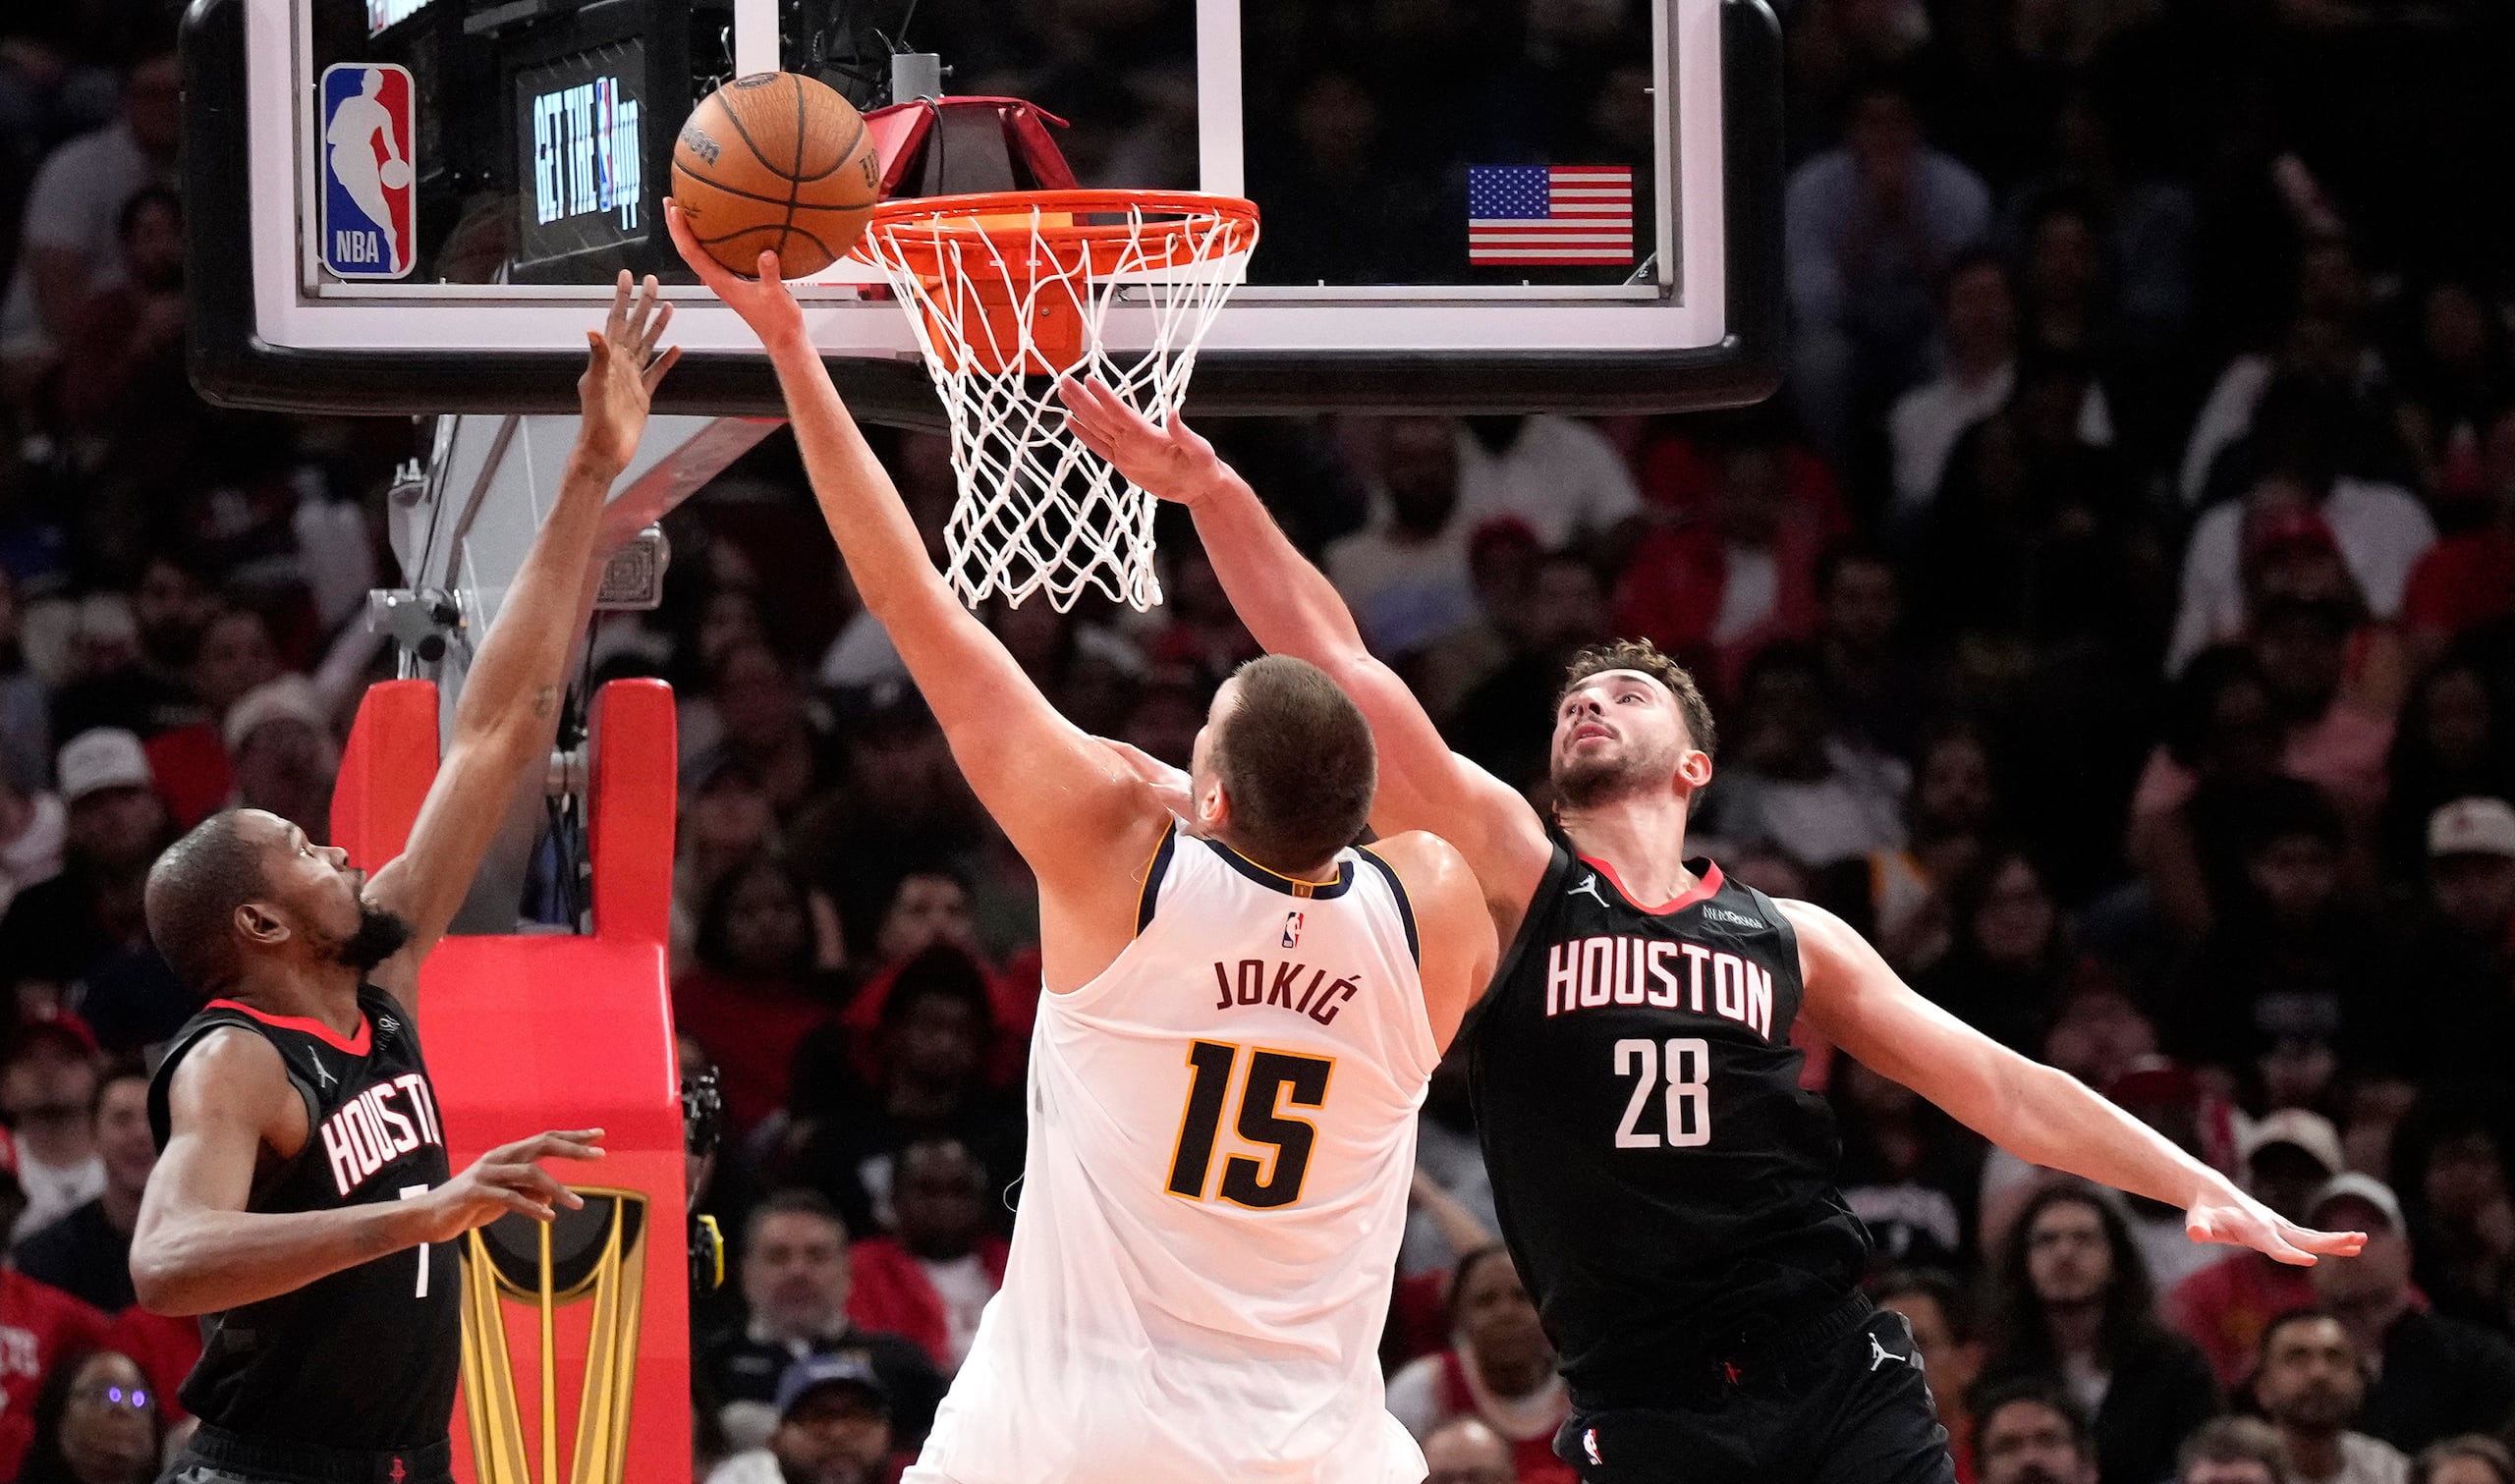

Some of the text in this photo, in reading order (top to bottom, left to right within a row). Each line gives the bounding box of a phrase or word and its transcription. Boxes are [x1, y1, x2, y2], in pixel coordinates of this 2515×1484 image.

[564, 83, 597, 216] THE
[336, 230, 380, 263] NBA
[1214, 959, 1362, 1026] JOKIĆ
[1545, 936, 1774, 1043] HOUSTON
[1164, 1038, 1337, 1211] 15
[1614, 1037, 1711, 1148] 28
